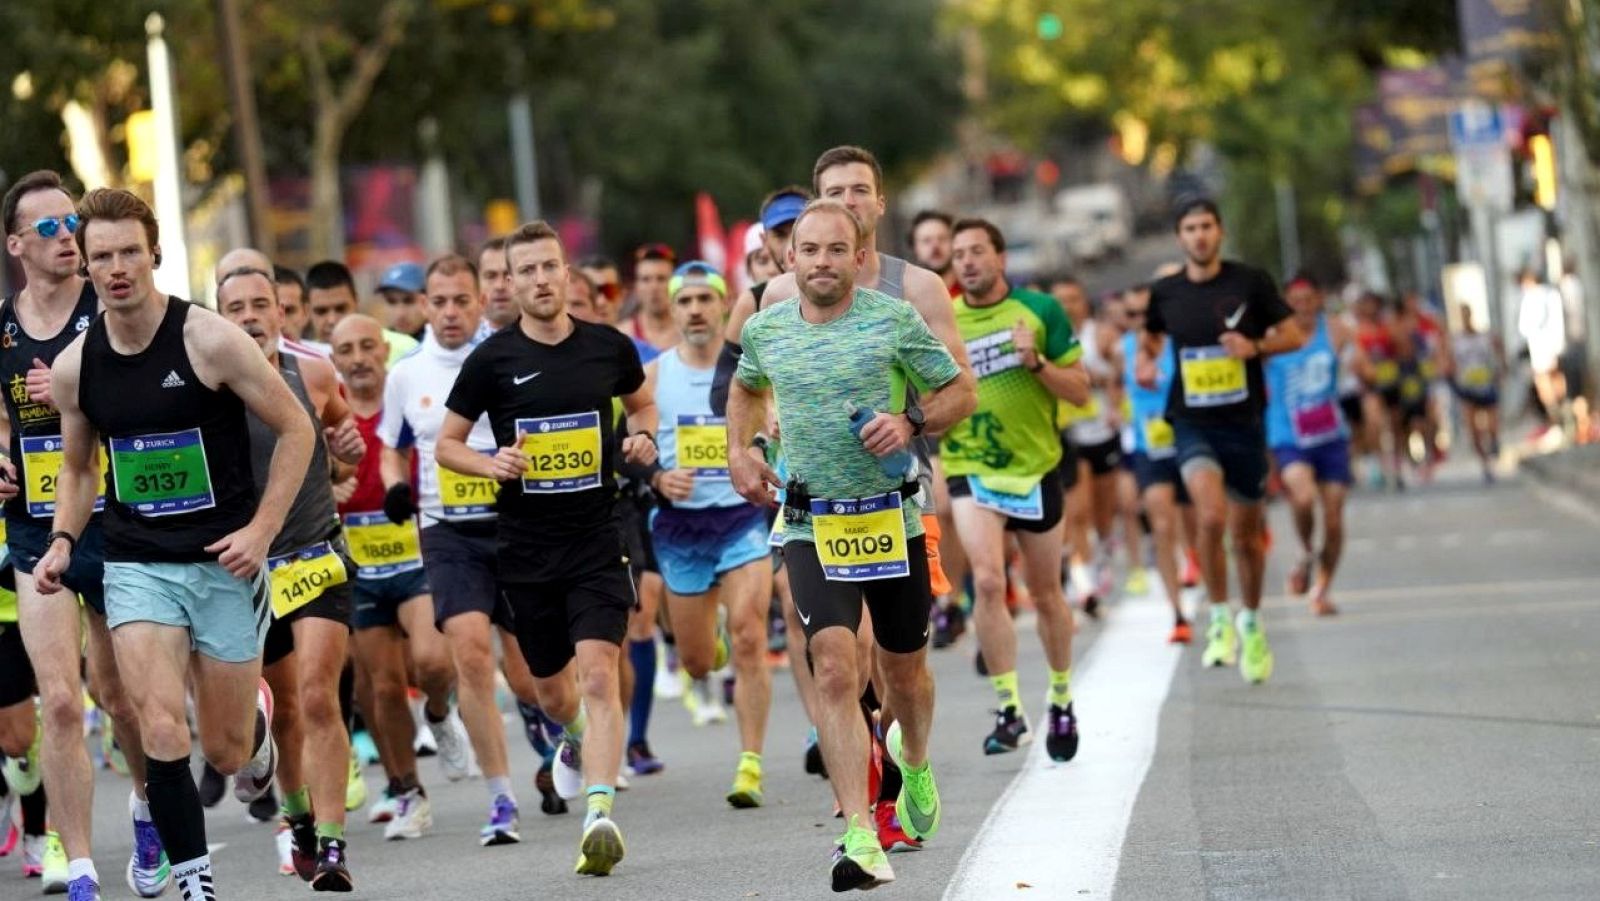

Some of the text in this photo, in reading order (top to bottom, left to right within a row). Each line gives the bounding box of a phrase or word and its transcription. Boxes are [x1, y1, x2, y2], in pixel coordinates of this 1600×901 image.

[145, 440, 175, 448] ZURICH
[531, 450, 594, 472] 12330
[133, 472, 188, 493] 3137
[454, 481, 497, 498] 9711
[361, 542, 405, 558] 1888
[825, 534, 893, 557] 10109
[281, 567, 332, 603] 14101
